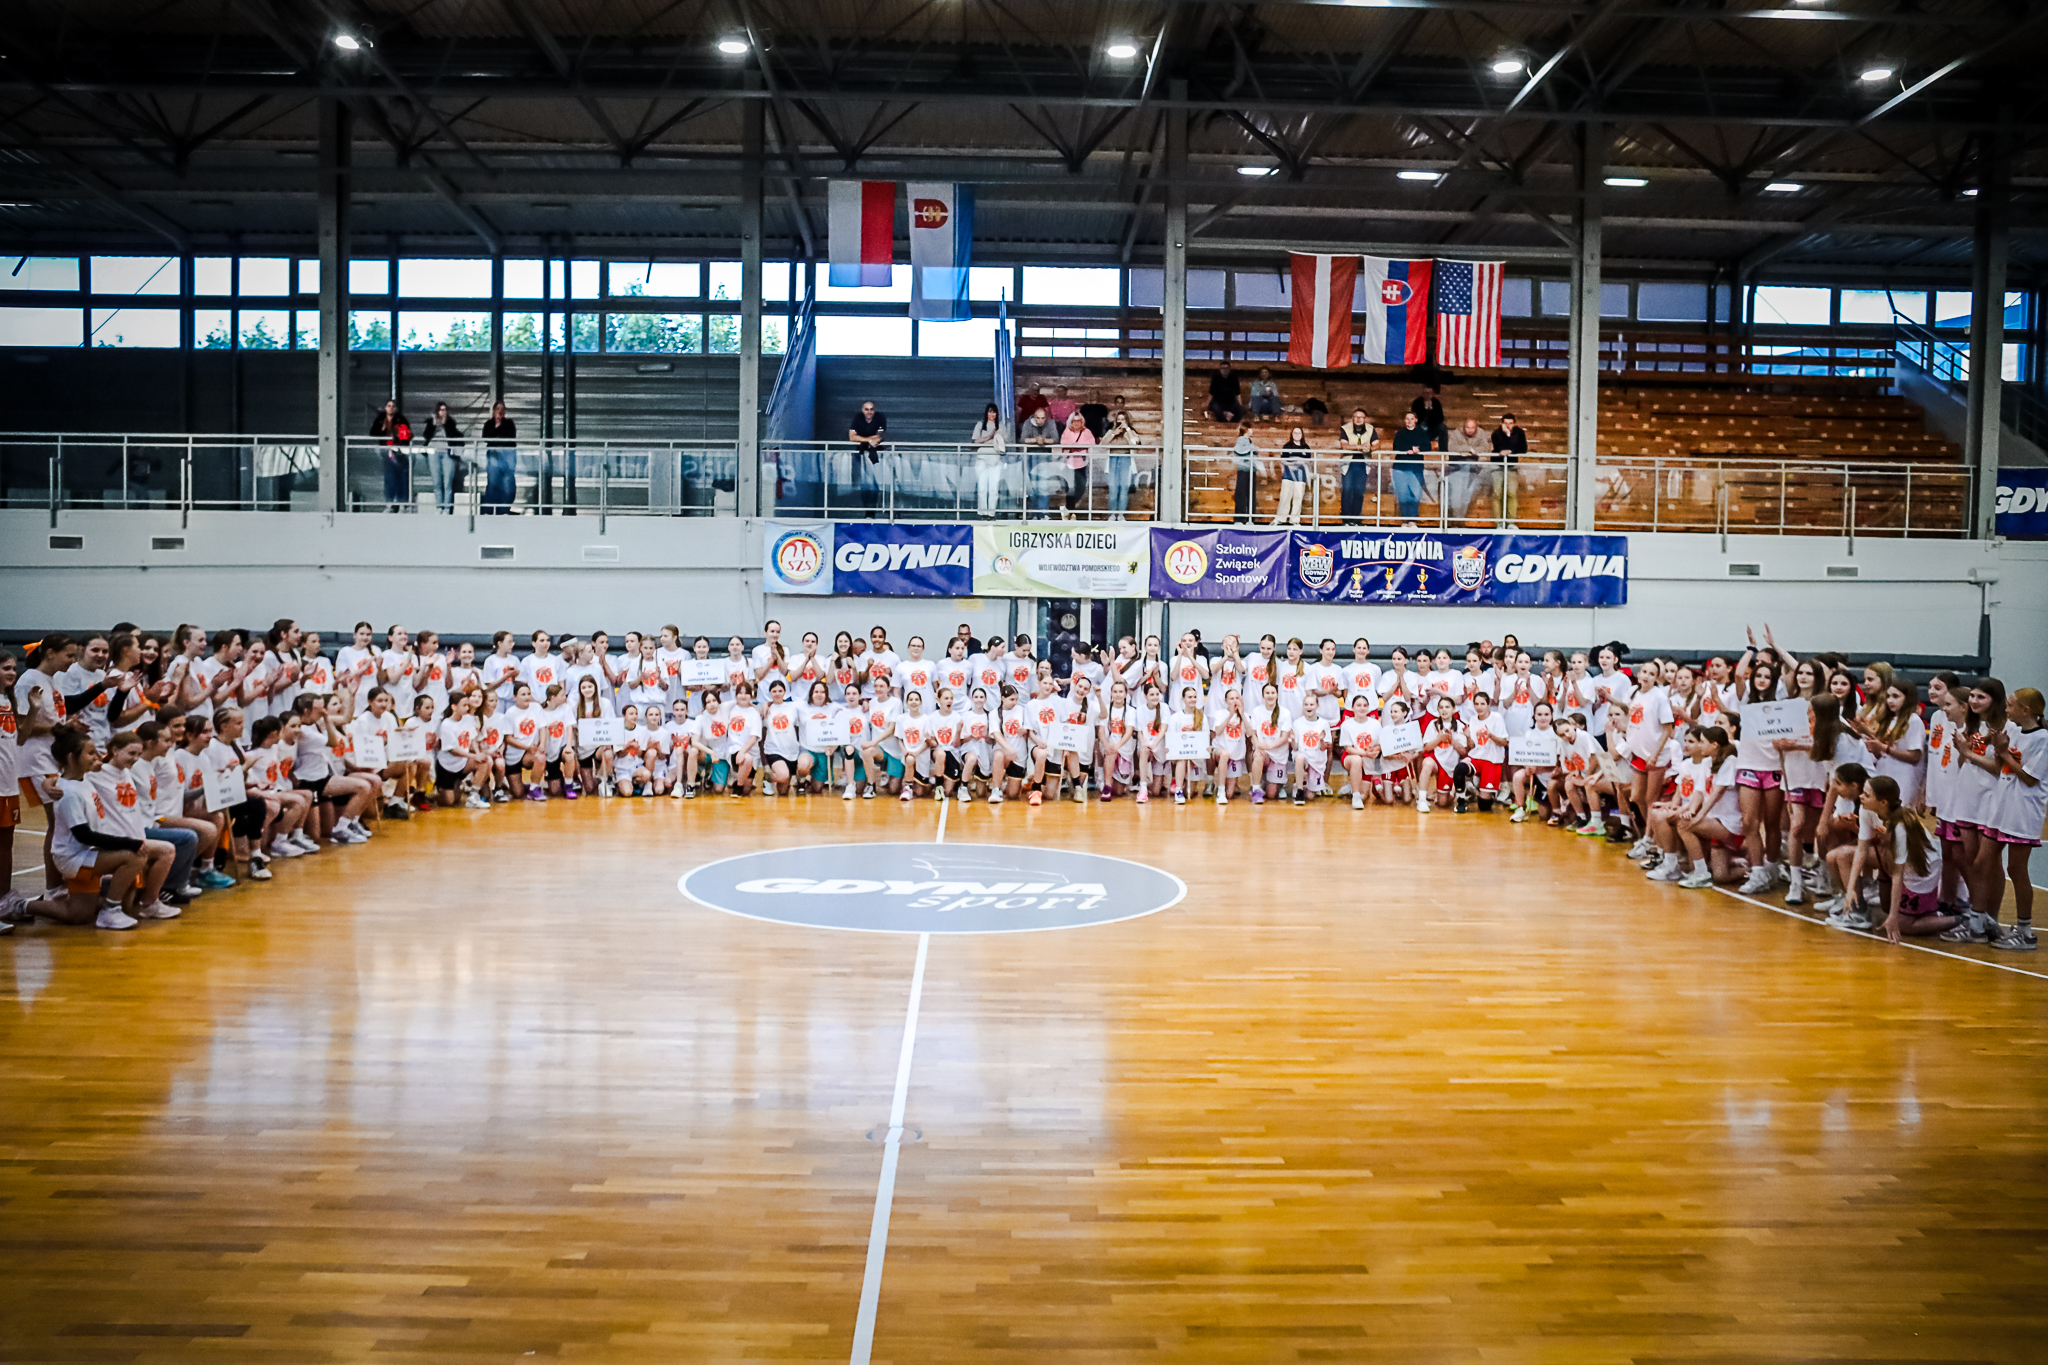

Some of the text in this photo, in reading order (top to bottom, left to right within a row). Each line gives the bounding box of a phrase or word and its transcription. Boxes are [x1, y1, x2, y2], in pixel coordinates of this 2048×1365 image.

[1010, 532, 1116, 549] IGRZYSKA DZIECI
[1216, 544, 1257, 557] Szkolny
[1340, 540, 1444, 560] VBW GDYNIA
[835, 542, 970, 572] GDYNIA
[1300, 557, 1332, 569] VBW
[787, 560, 812, 572] SZS
[1038, 563, 1080, 572] WOJEWÓDZTWA
[1174, 564, 1198, 575] SZS
[1215, 558, 1260, 571] Związek
[1454, 559, 1484, 571] VBW
[1495, 554, 1624, 583] GDYNIA
[1215, 573, 1268, 585] Sportowy
[735, 878, 1108, 896] GDYNIA
[906, 892, 1109, 912] sport
[1900, 894, 1919, 910] 24
